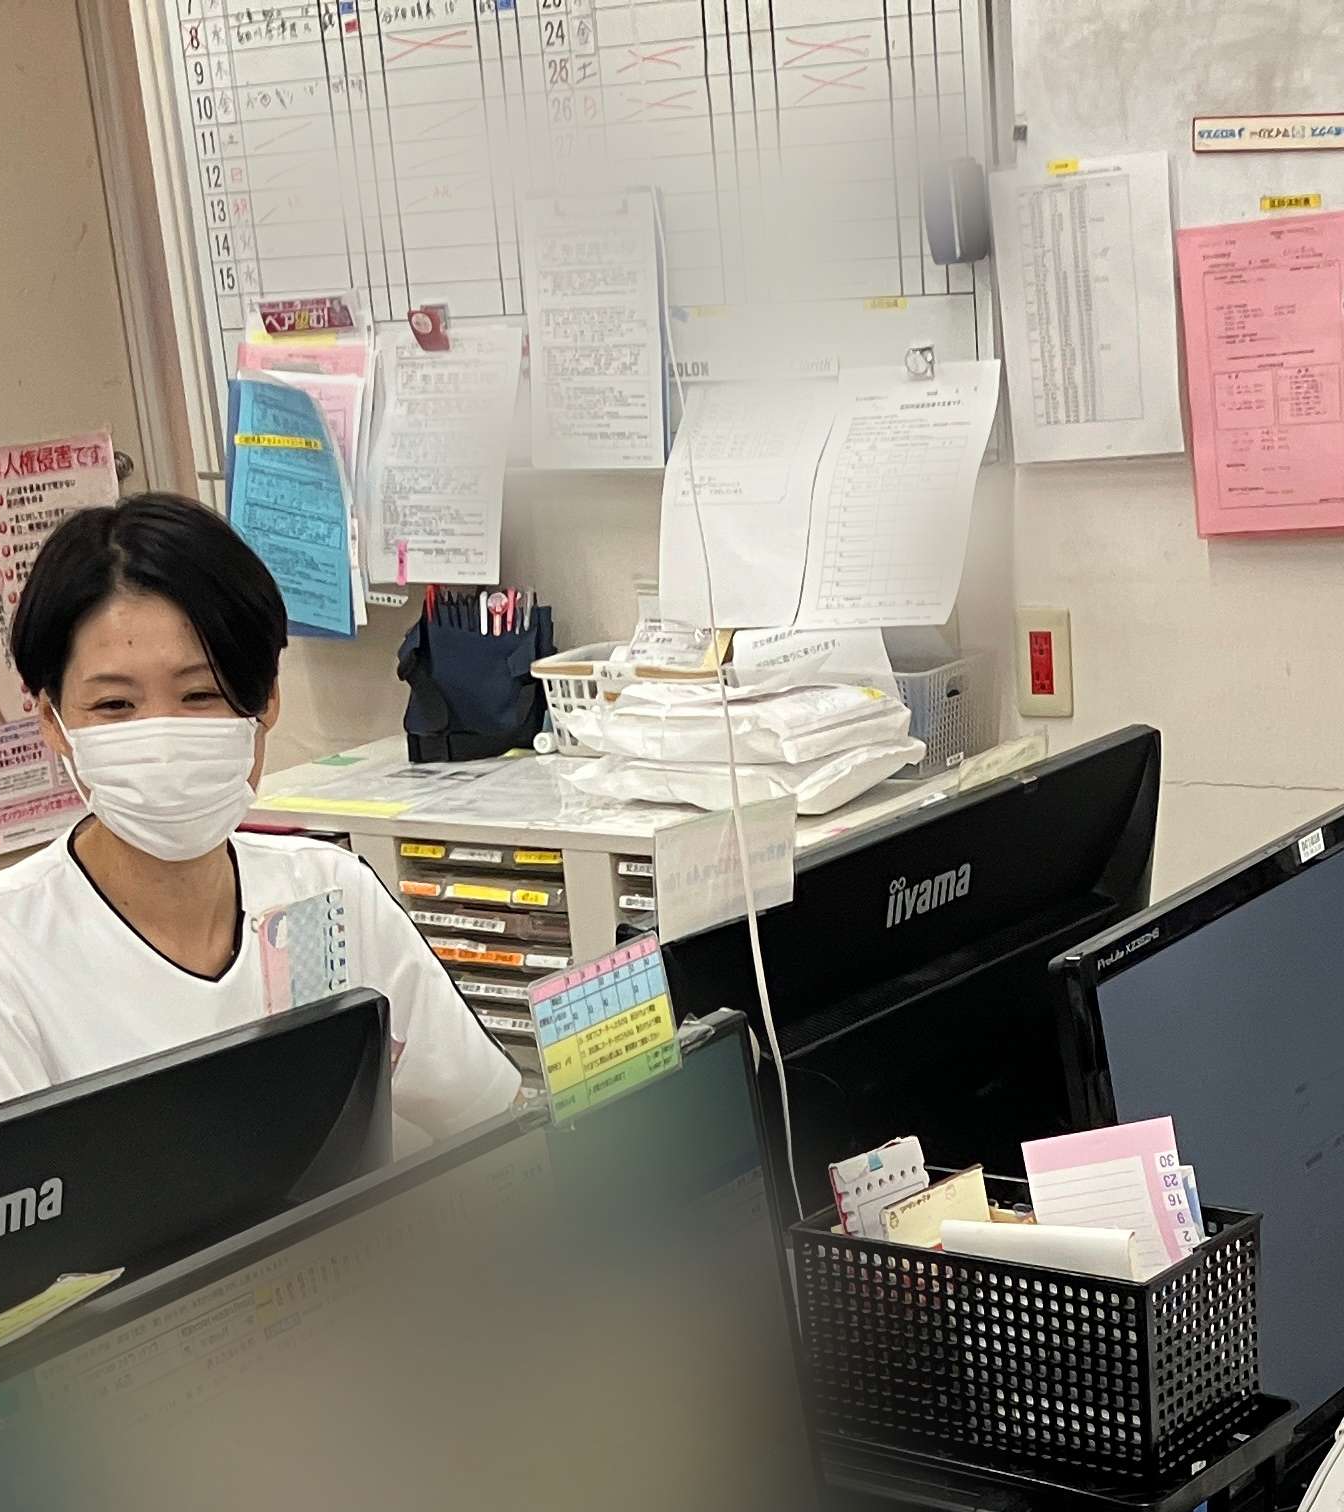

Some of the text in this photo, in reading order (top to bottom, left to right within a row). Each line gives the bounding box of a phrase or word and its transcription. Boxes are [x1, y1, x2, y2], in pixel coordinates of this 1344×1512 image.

[545, 20, 565, 47] 24
[194, 61, 204, 85] 9
[196, 96, 213, 120] 10
[202, 131, 216, 154] 11
[206, 165, 222, 188] 12
[210, 199, 227, 223] 13
[215, 234, 231, 257] 14
[219, 267, 236, 291] 15
[885, 861, 973, 929] iiyama
[1158, 1153, 1176, 1168] 30
[1162, 1173, 1179, 1188] 23
[1167, 1193, 1183, 1207] 16
[1182, 1230, 1192, 1243] 2
